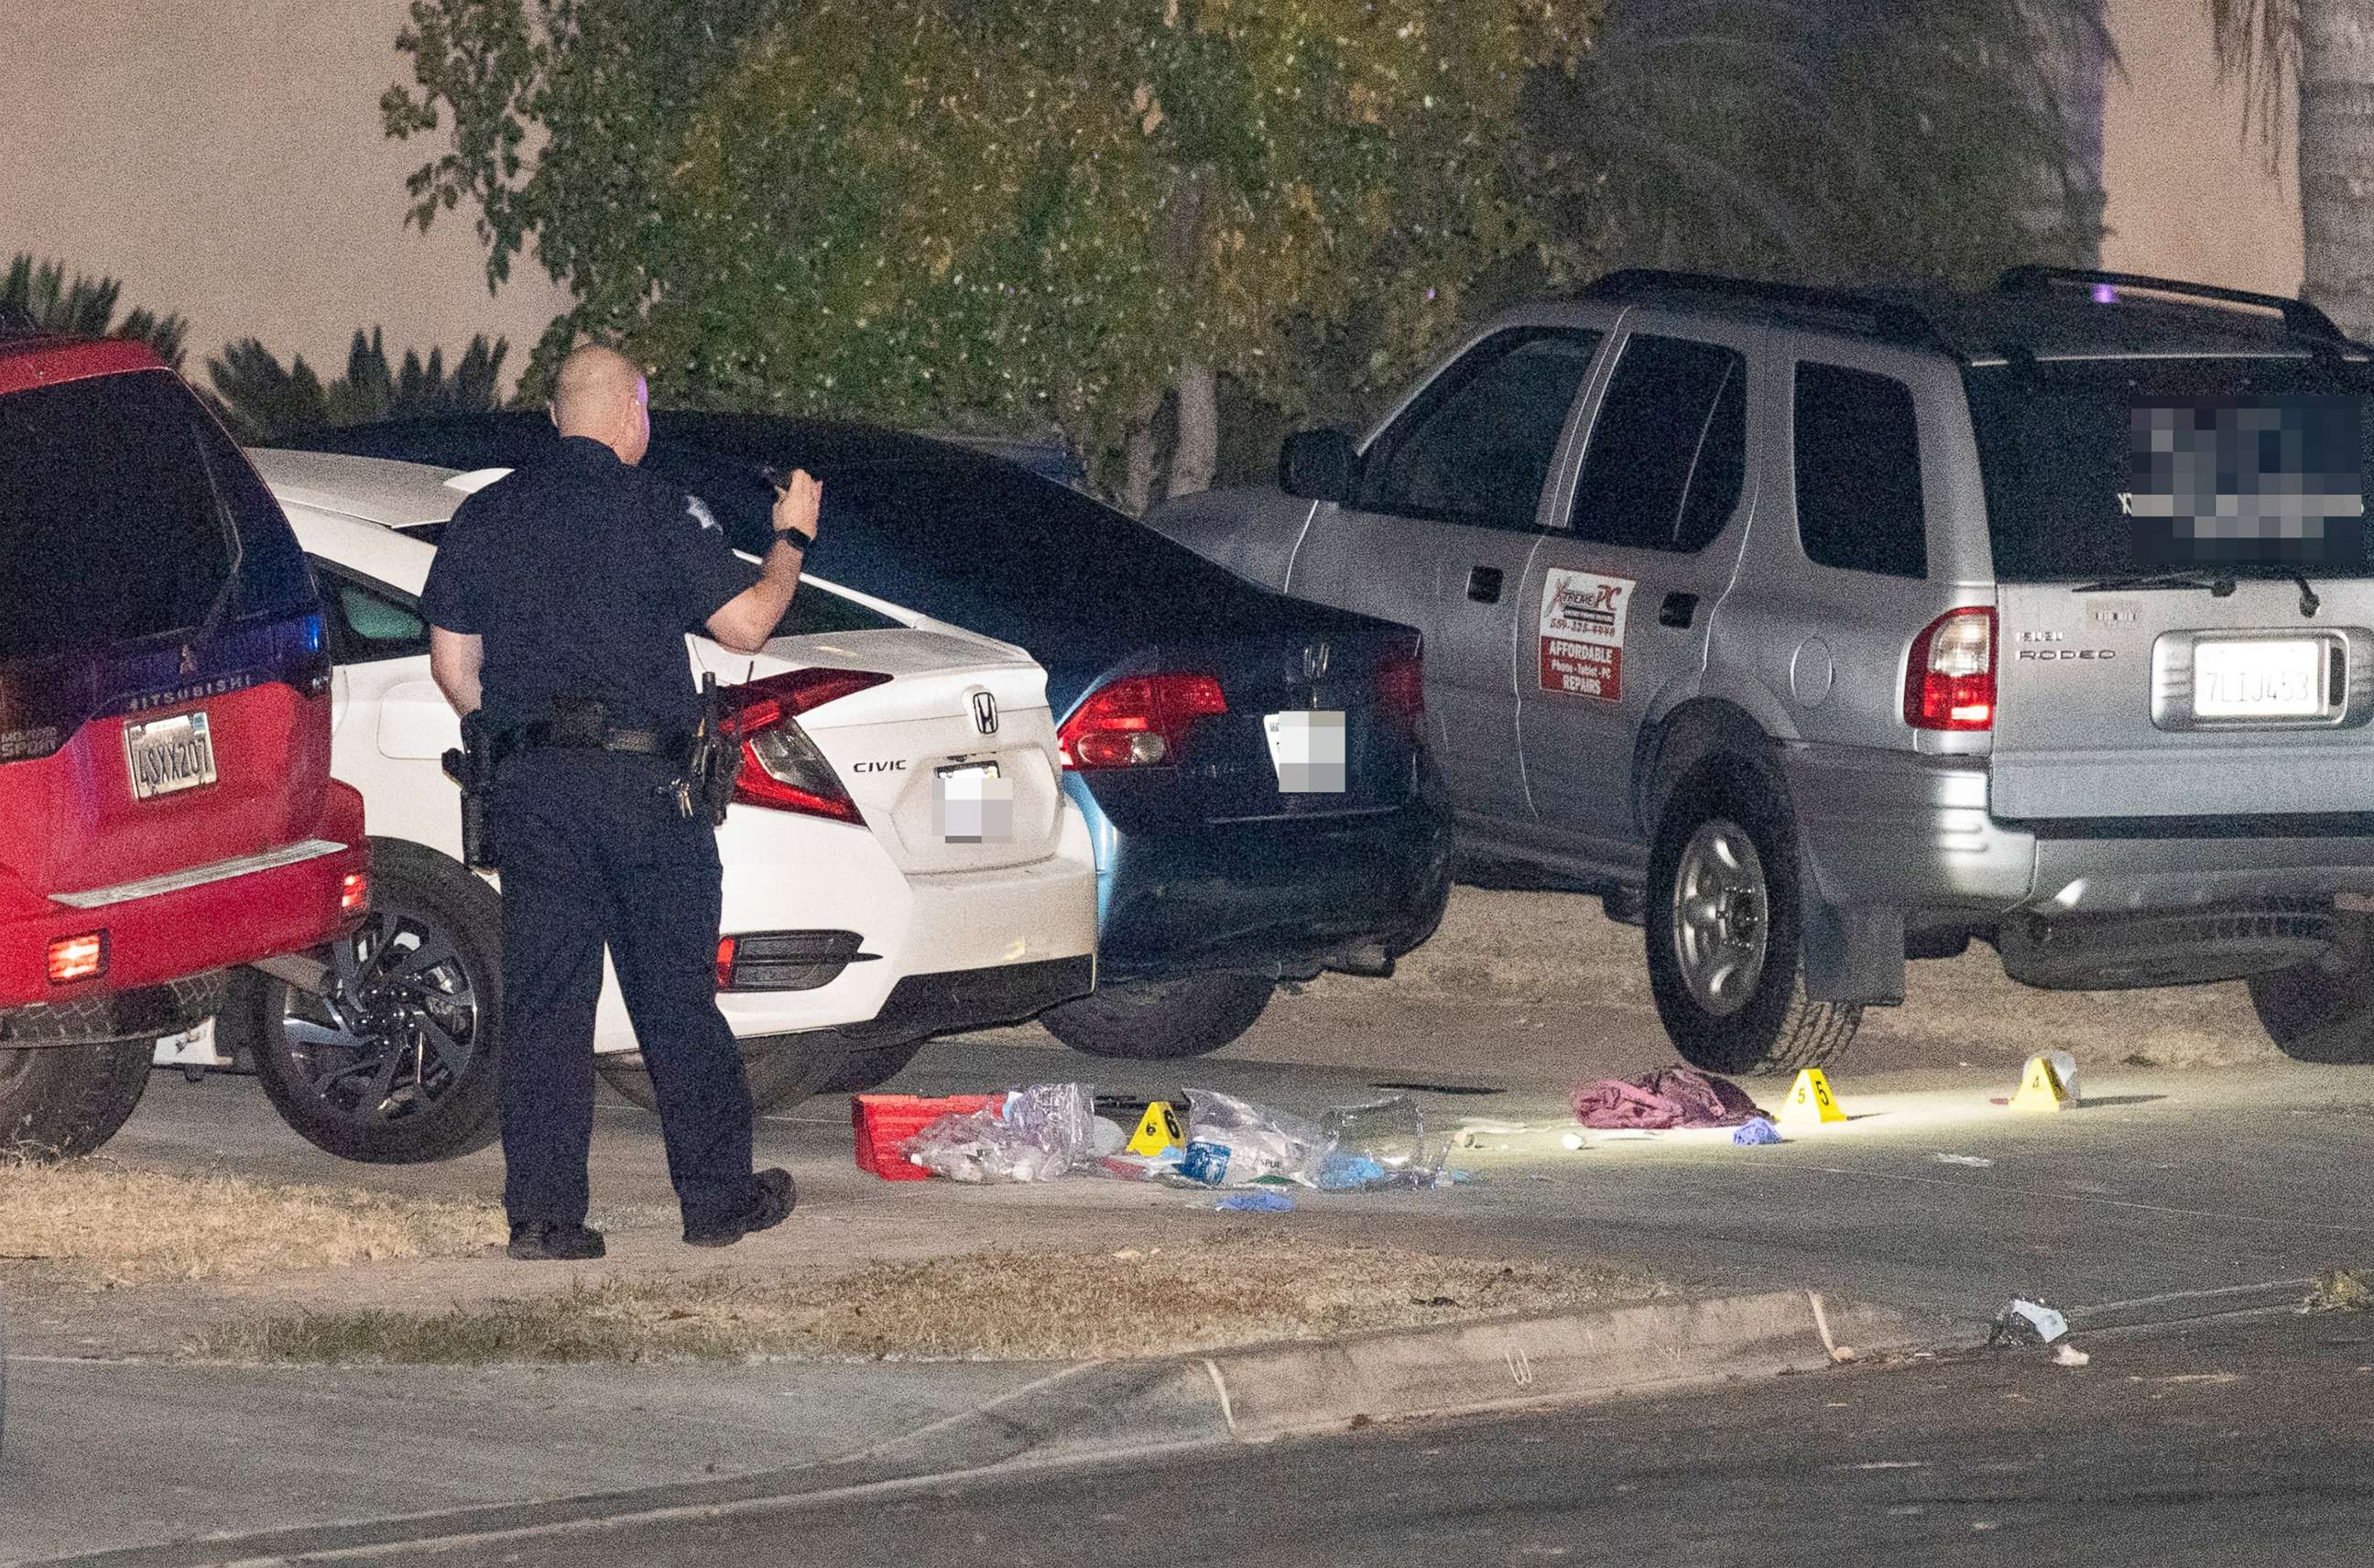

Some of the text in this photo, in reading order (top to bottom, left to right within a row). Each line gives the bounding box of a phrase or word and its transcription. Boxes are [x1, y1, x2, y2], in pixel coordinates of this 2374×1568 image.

[1550, 640, 1613, 663] AFFORDABLE
[2015, 649, 2116, 659] RODEO
[1563, 674, 1601, 695] REPAIRS
[854, 759, 908, 773] CIVIC
[1798, 1081, 1830, 1106] 5 5
[1147, 1109, 1181, 1139] 6 6
